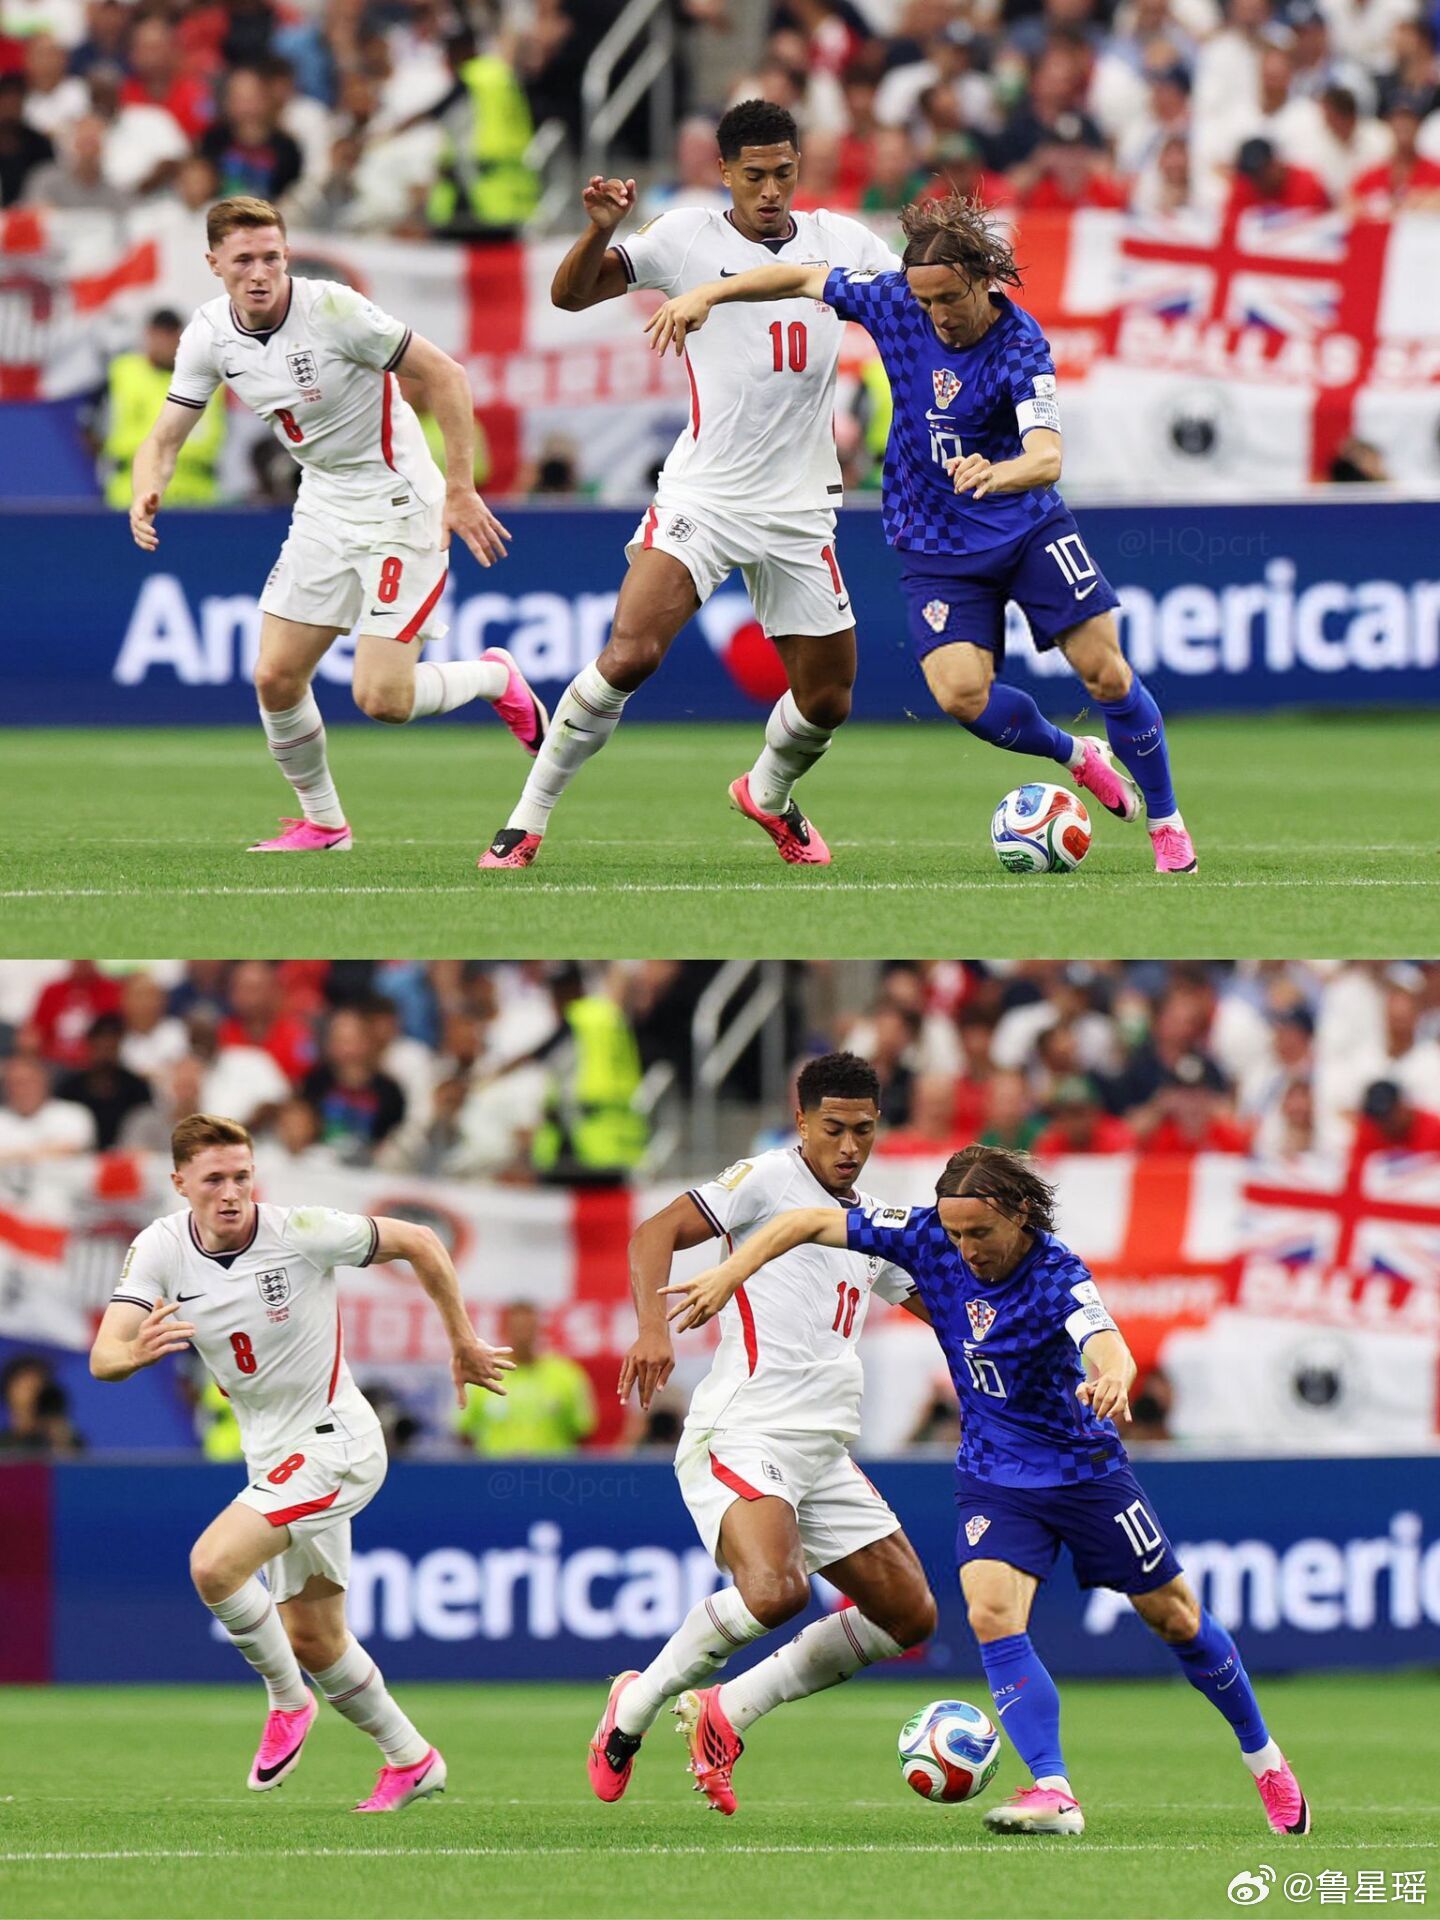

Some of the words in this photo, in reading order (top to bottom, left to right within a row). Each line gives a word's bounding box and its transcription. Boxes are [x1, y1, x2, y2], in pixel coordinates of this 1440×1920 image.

[768, 320, 807, 372] 10
[274, 408, 304, 443] 8
[928, 429, 963, 470] 10
[377, 556, 403, 603] 8
[1044, 533, 1096, 585] 10
[1131, 725, 1158, 743] HNS
[832, 1281, 860, 1338] 10
[230, 1332, 257, 1374] 8
[963, 1357, 1008, 1398] 10
[267, 1453, 305, 1484] 8
[1113, 1499, 1162, 1556] 10
[1208, 1655, 1233, 1678] HNS
